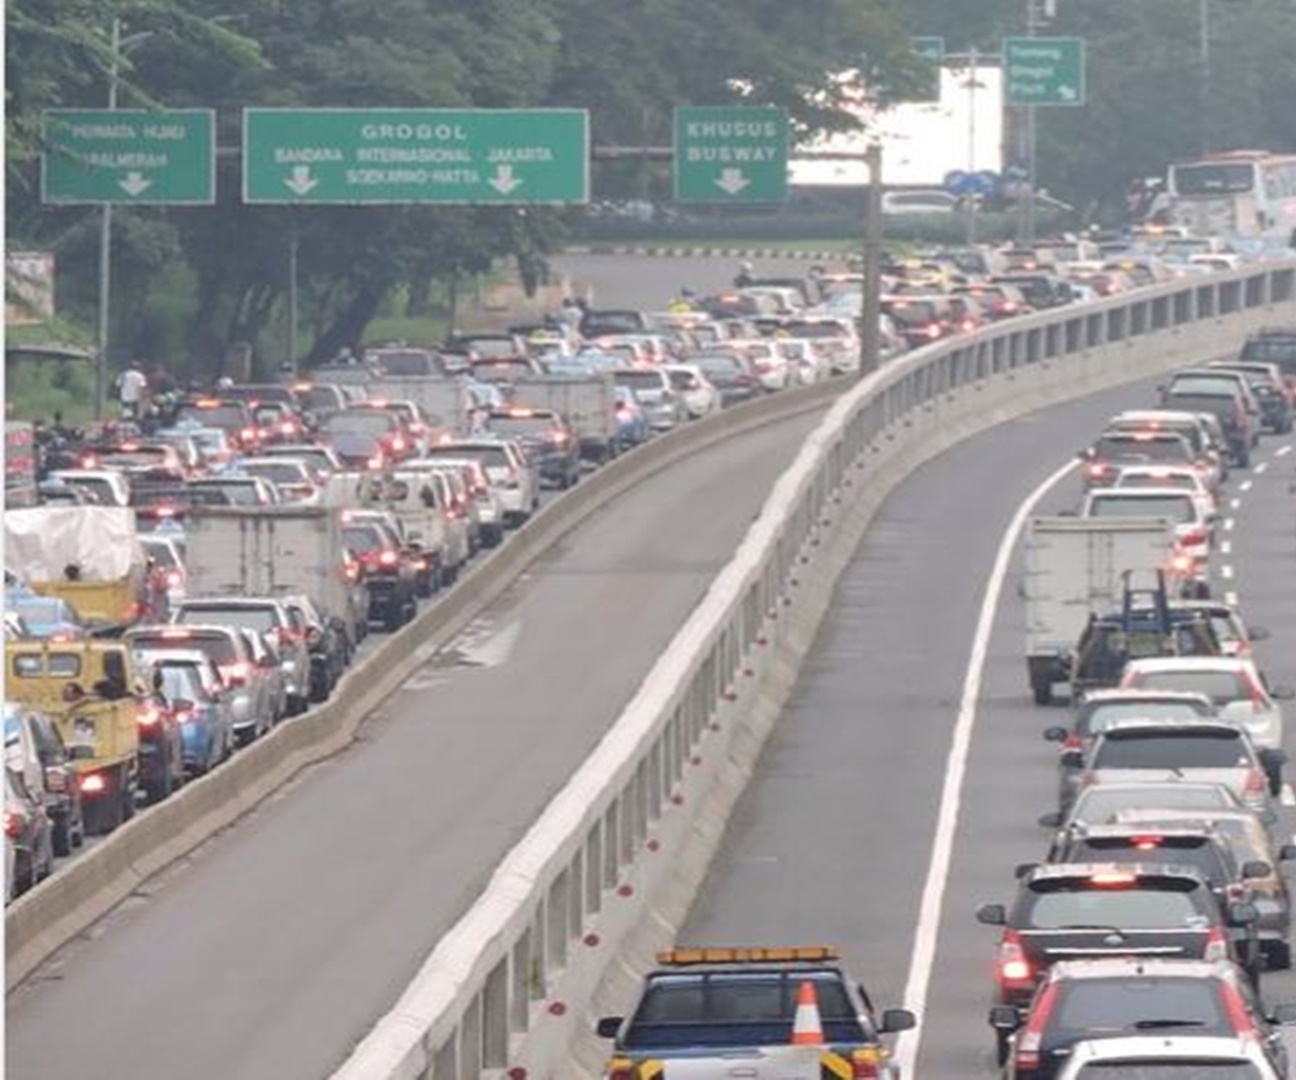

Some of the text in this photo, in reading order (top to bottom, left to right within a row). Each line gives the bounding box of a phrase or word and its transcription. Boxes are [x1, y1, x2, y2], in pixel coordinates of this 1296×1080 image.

[361, 123, 467, 140] GROGOL
[687, 121, 776, 138] KHUSUS
[275, 148, 344, 163] BANDARA
[487, 147, 555, 162] JAKARTA
[687, 146, 776, 161] BUSWAY
